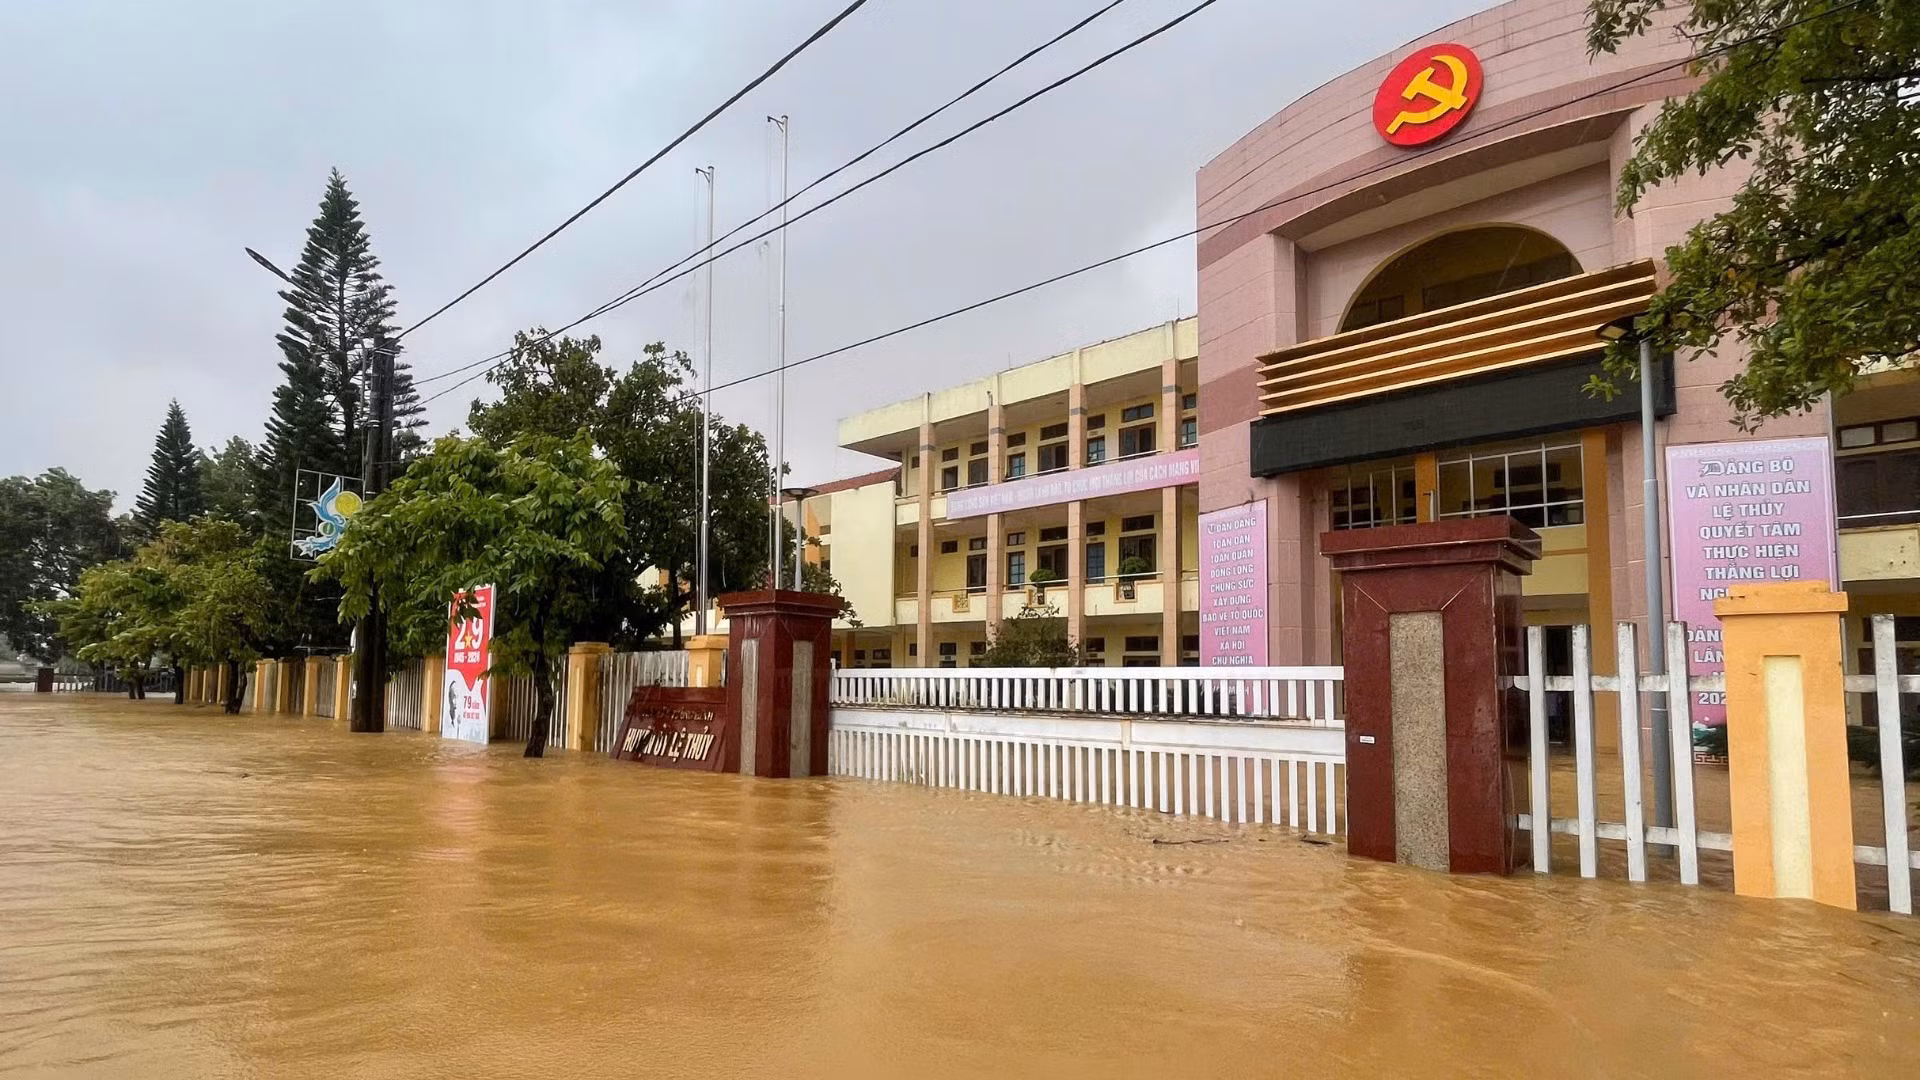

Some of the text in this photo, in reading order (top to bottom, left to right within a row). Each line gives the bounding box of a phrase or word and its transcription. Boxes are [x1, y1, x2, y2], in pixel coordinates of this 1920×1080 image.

[1769, 456, 1794, 474] BỘ
[1686, 478, 1810, 498] VÀ NHÂN DÂN
[1712, 500, 1784, 520] LỆ THỦY
[1699, 521, 1800, 540] QUYẾT TÂM
[1702, 543, 1799, 560] THỰC HIỆN
[1704, 563, 1799, 581] THẮNG LỢI
[1700, 587, 1728, 600] NG
[1698, 692, 1727, 705] 202
[622, 725, 656, 757] HUYN
[682, 725, 715, 761] THỦY
